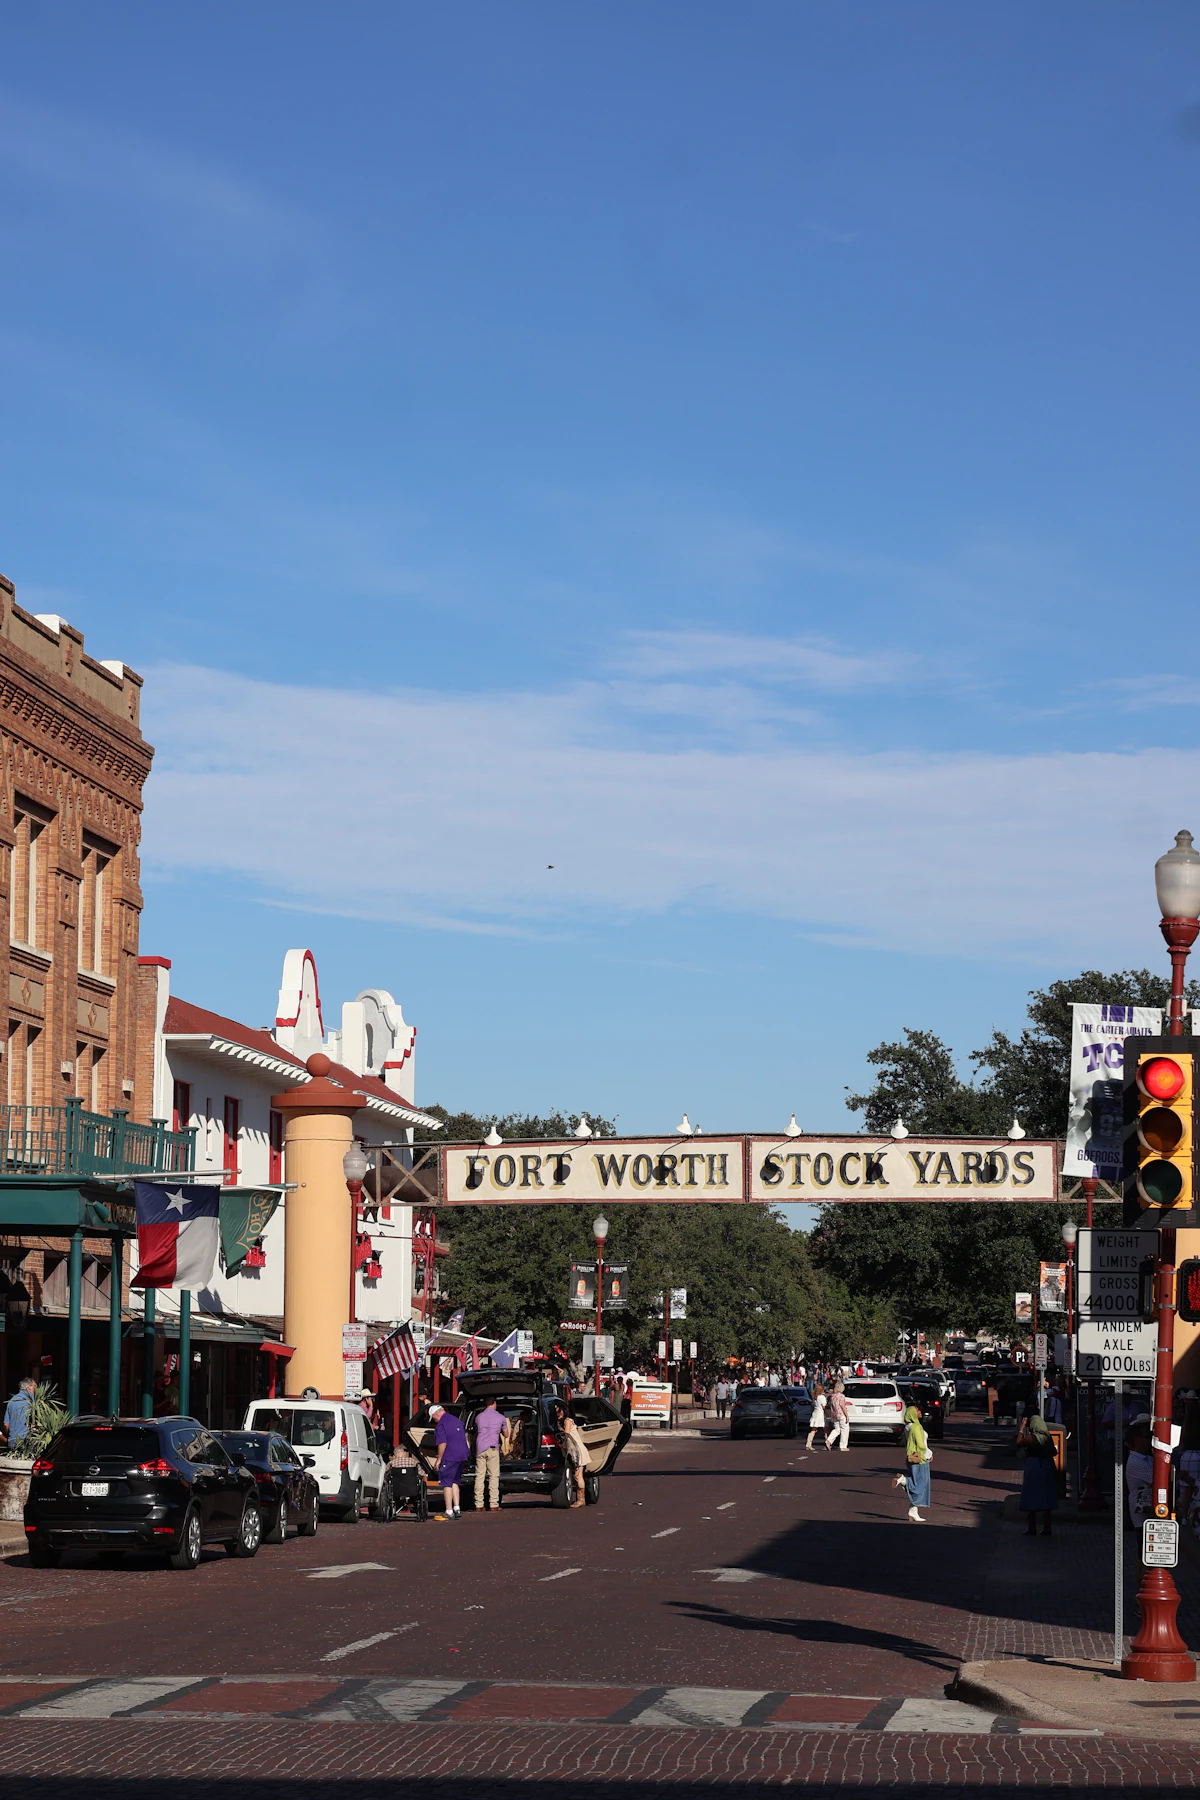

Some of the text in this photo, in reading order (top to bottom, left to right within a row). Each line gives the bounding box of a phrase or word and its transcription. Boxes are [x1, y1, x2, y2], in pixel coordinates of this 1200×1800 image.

[1080, 1023, 1093, 1034] THE
[1096, 1024, 1124, 1035] CARTER
[467, 1151, 1035, 1188] FORT WORTH STOCK YARDS
[1097, 1235, 1140, 1248] WEIGHT
[1099, 1255, 1138, 1268] LIMITS
[1099, 1277, 1138, 1290] GROSS
[567, 1321, 587, 1330] Rodeo
[1095, 1321, 1142, 1333] TANDEM
[1103, 1338, 1134, 1351] AXLE
